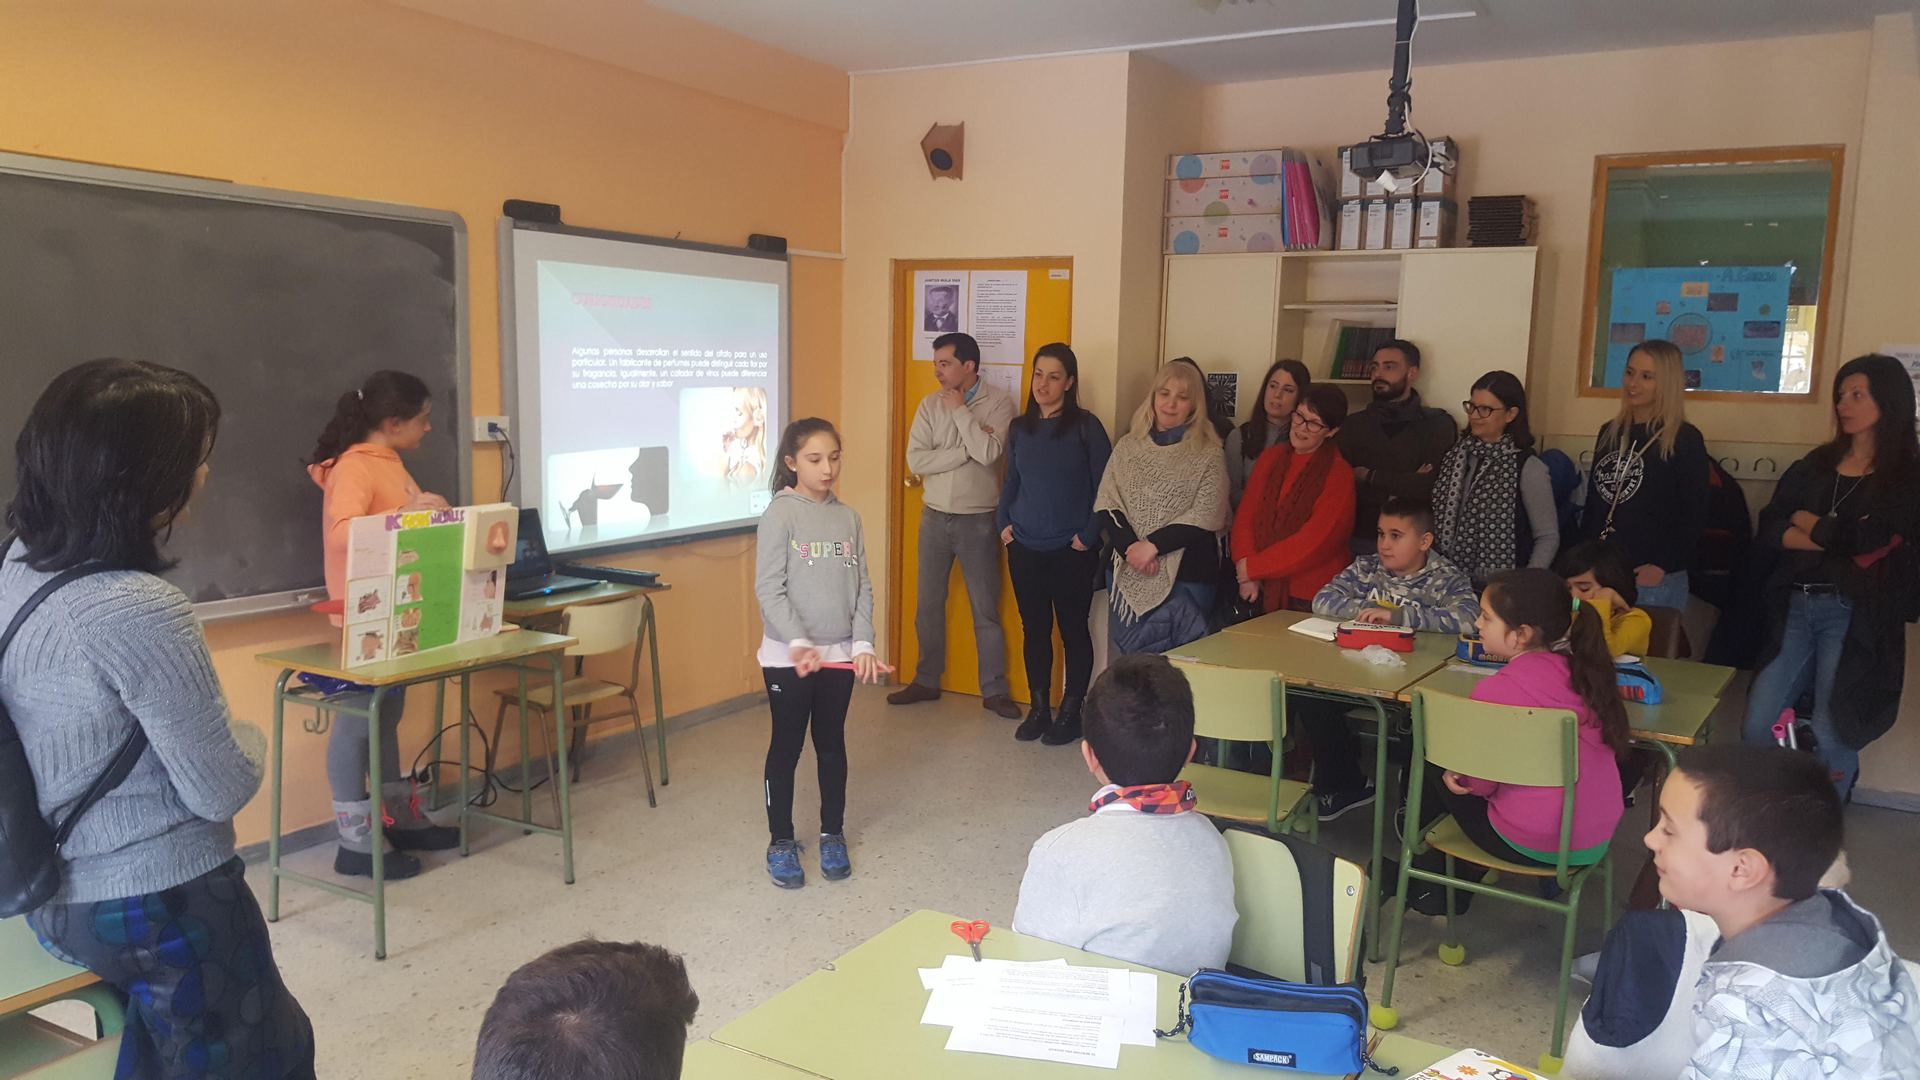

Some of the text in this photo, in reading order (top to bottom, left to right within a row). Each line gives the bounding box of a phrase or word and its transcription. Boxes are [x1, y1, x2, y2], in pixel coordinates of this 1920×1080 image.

[572, 347, 600, 357] Algunas
[603, 348, 632, 357] personas
[799, 540, 852, 559] SUPER
[1254, 1052, 1290, 1065] SAMPACK
